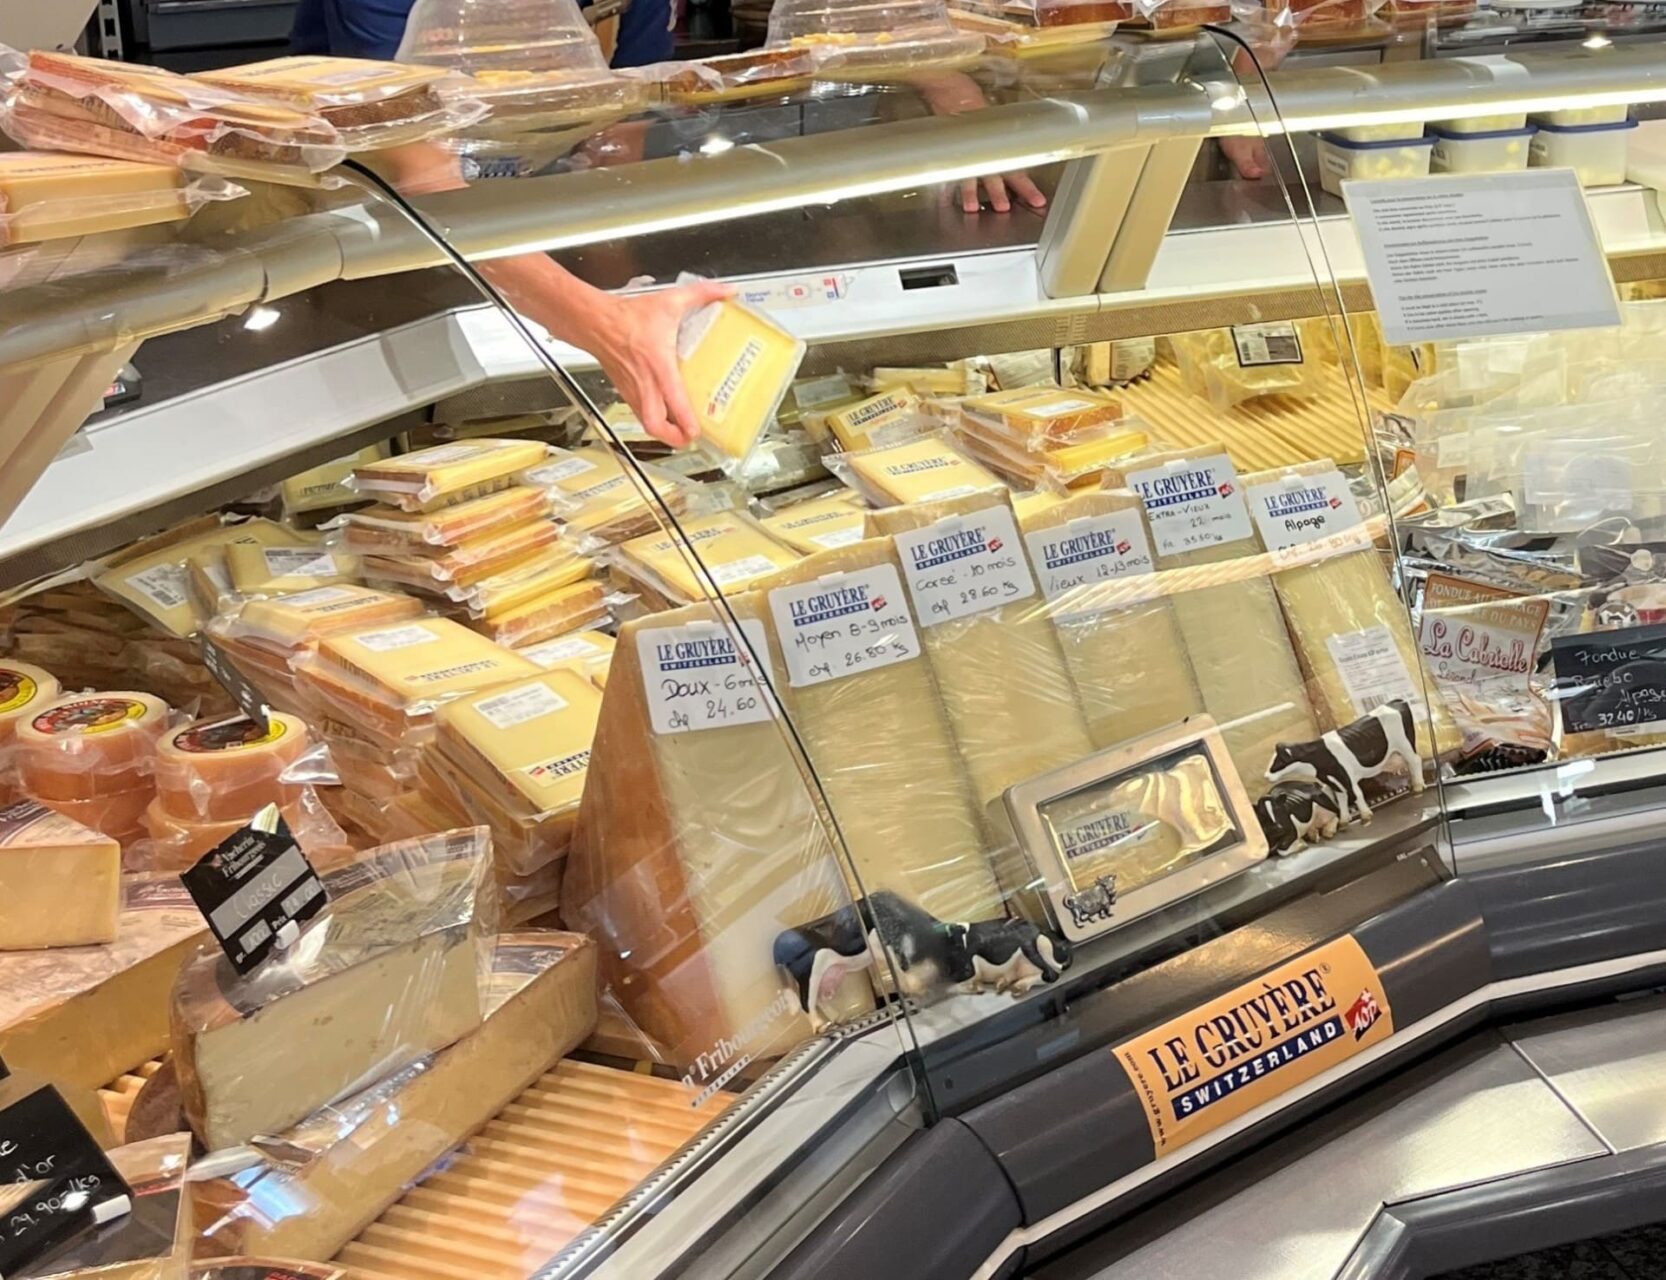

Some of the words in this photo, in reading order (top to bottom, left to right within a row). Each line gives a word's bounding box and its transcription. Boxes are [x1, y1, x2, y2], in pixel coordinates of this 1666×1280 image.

[1264, 497, 1279, 510] LE
[1285, 515, 1325, 532] Alpage
[911, 545, 928, 561] LE
[1043, 543, 1059, 560] LE
[1432, 583, 1472, 601] FONDUE
[789, 600, 806, 618] LE
[1424, 619, 1452, 658] La
[657, 645, 673, 661] LE
[1575, 648, 1640, 666] Fondue
[661, 678, 711, 702] Doux
[706, 697, 756, 719] 24.60
[1352, 1002, 1378, 1037] AOP
[1148, 1037, 1200, 1092] LE
[1180, 1021, 1337, 1113] SWITZERLAND
[1124, 1051, 1166, 1147] www.gruyere.com
